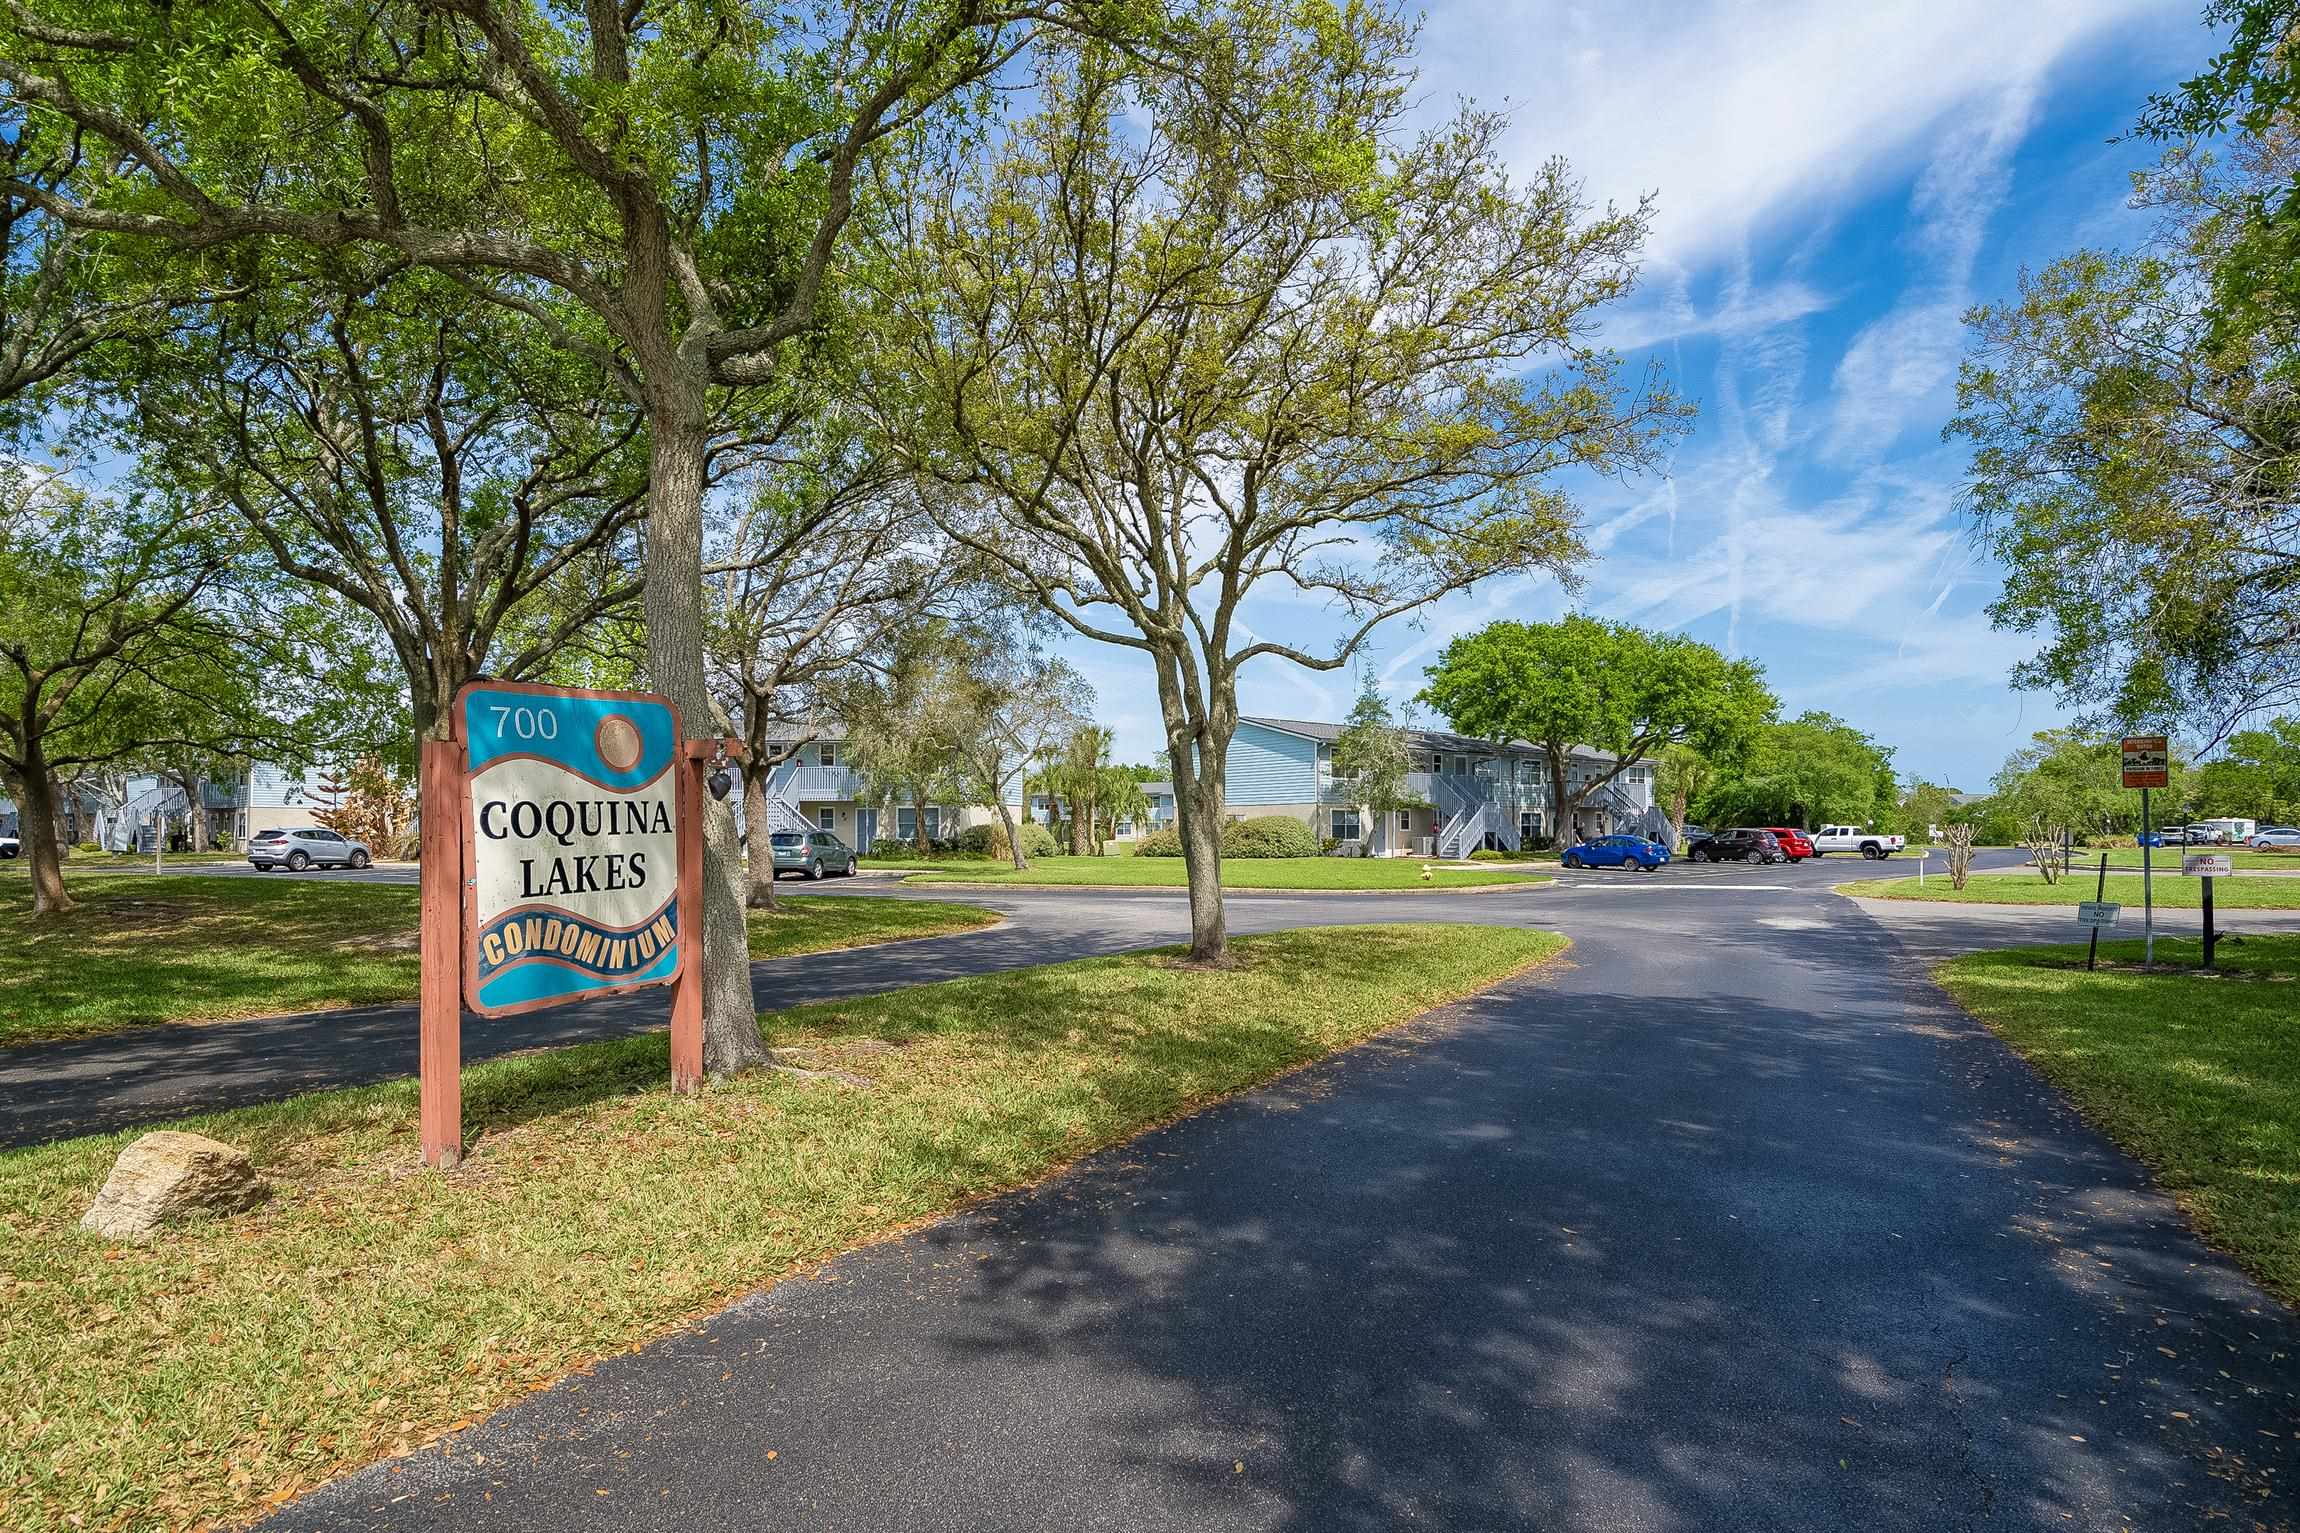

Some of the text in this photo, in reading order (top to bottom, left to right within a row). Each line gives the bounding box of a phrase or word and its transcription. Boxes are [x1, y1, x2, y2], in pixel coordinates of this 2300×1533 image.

[489, 705, 558, 740] 700
[479, 799, 673, 847] COQUINA
[519, 852, 647, 899] LAKES
[2200, 857, 2215, 865] NO
[482, 914, 676, 969] CONDOMINIUM
